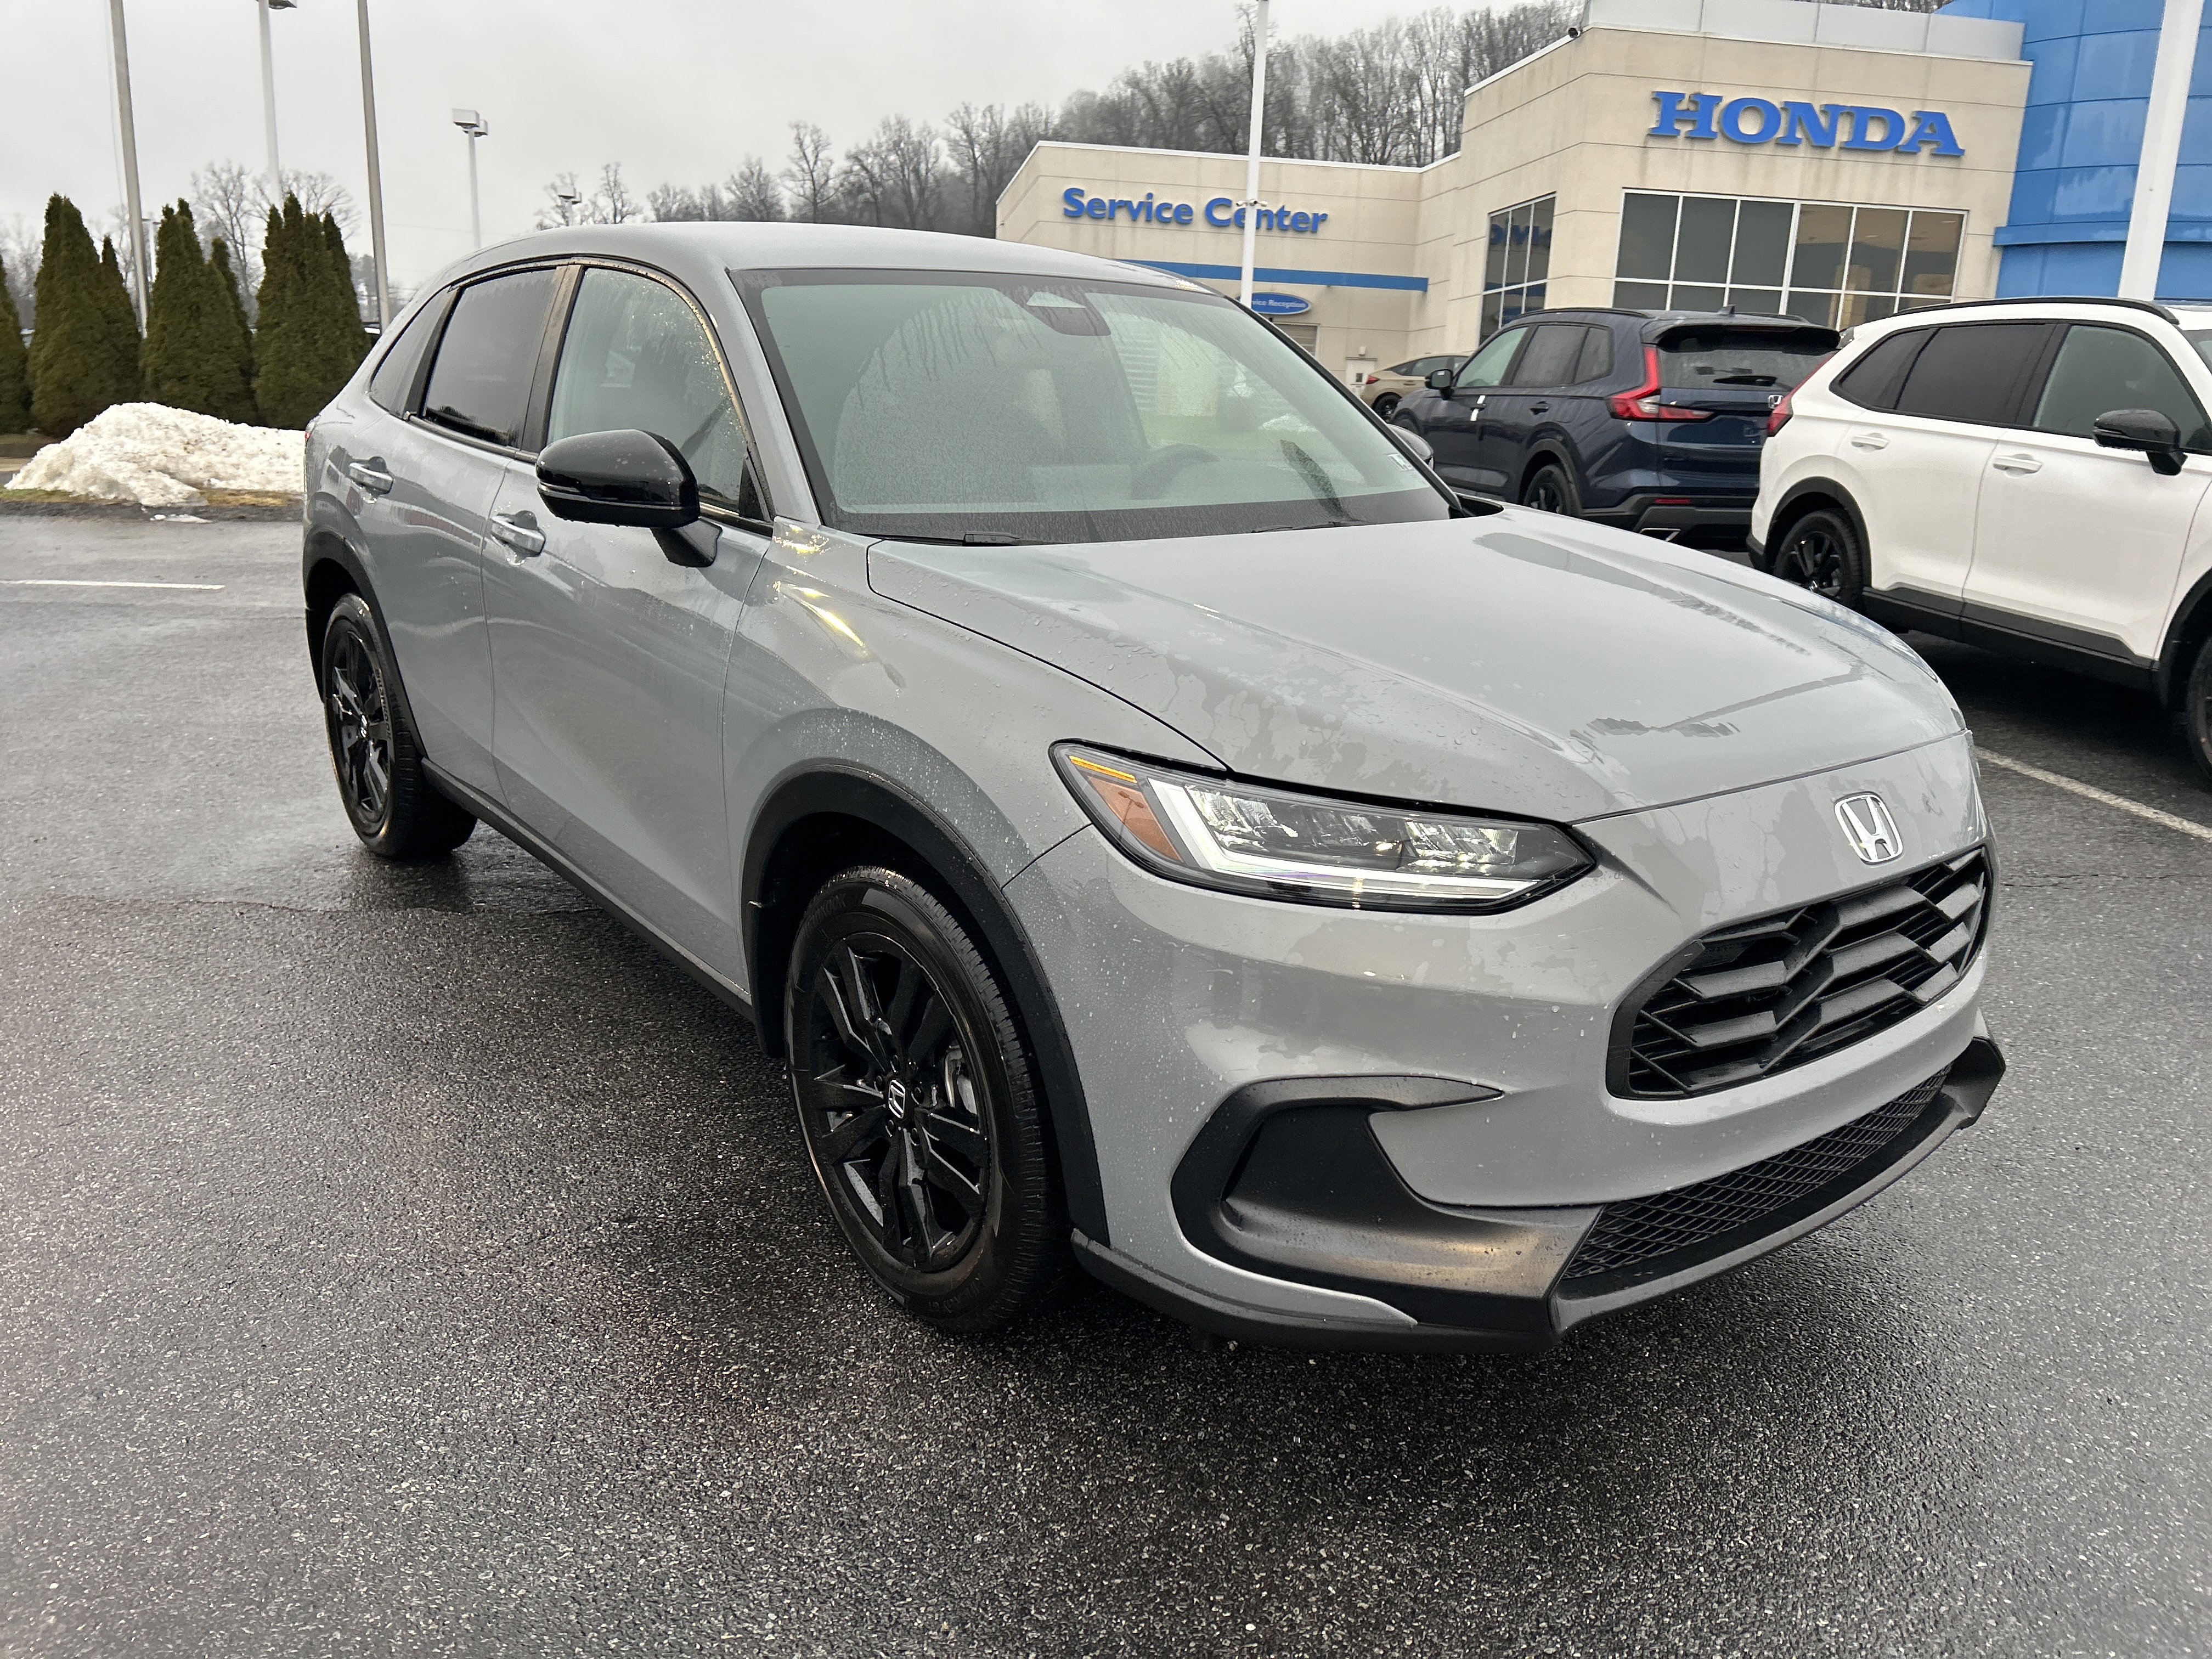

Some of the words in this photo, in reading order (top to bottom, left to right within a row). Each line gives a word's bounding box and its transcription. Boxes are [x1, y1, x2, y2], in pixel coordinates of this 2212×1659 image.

[1647, 91, 1966, 157] HONDA
[1063, 188, 1193, 224] Service
[1204, 198, 1328, 233] Center
